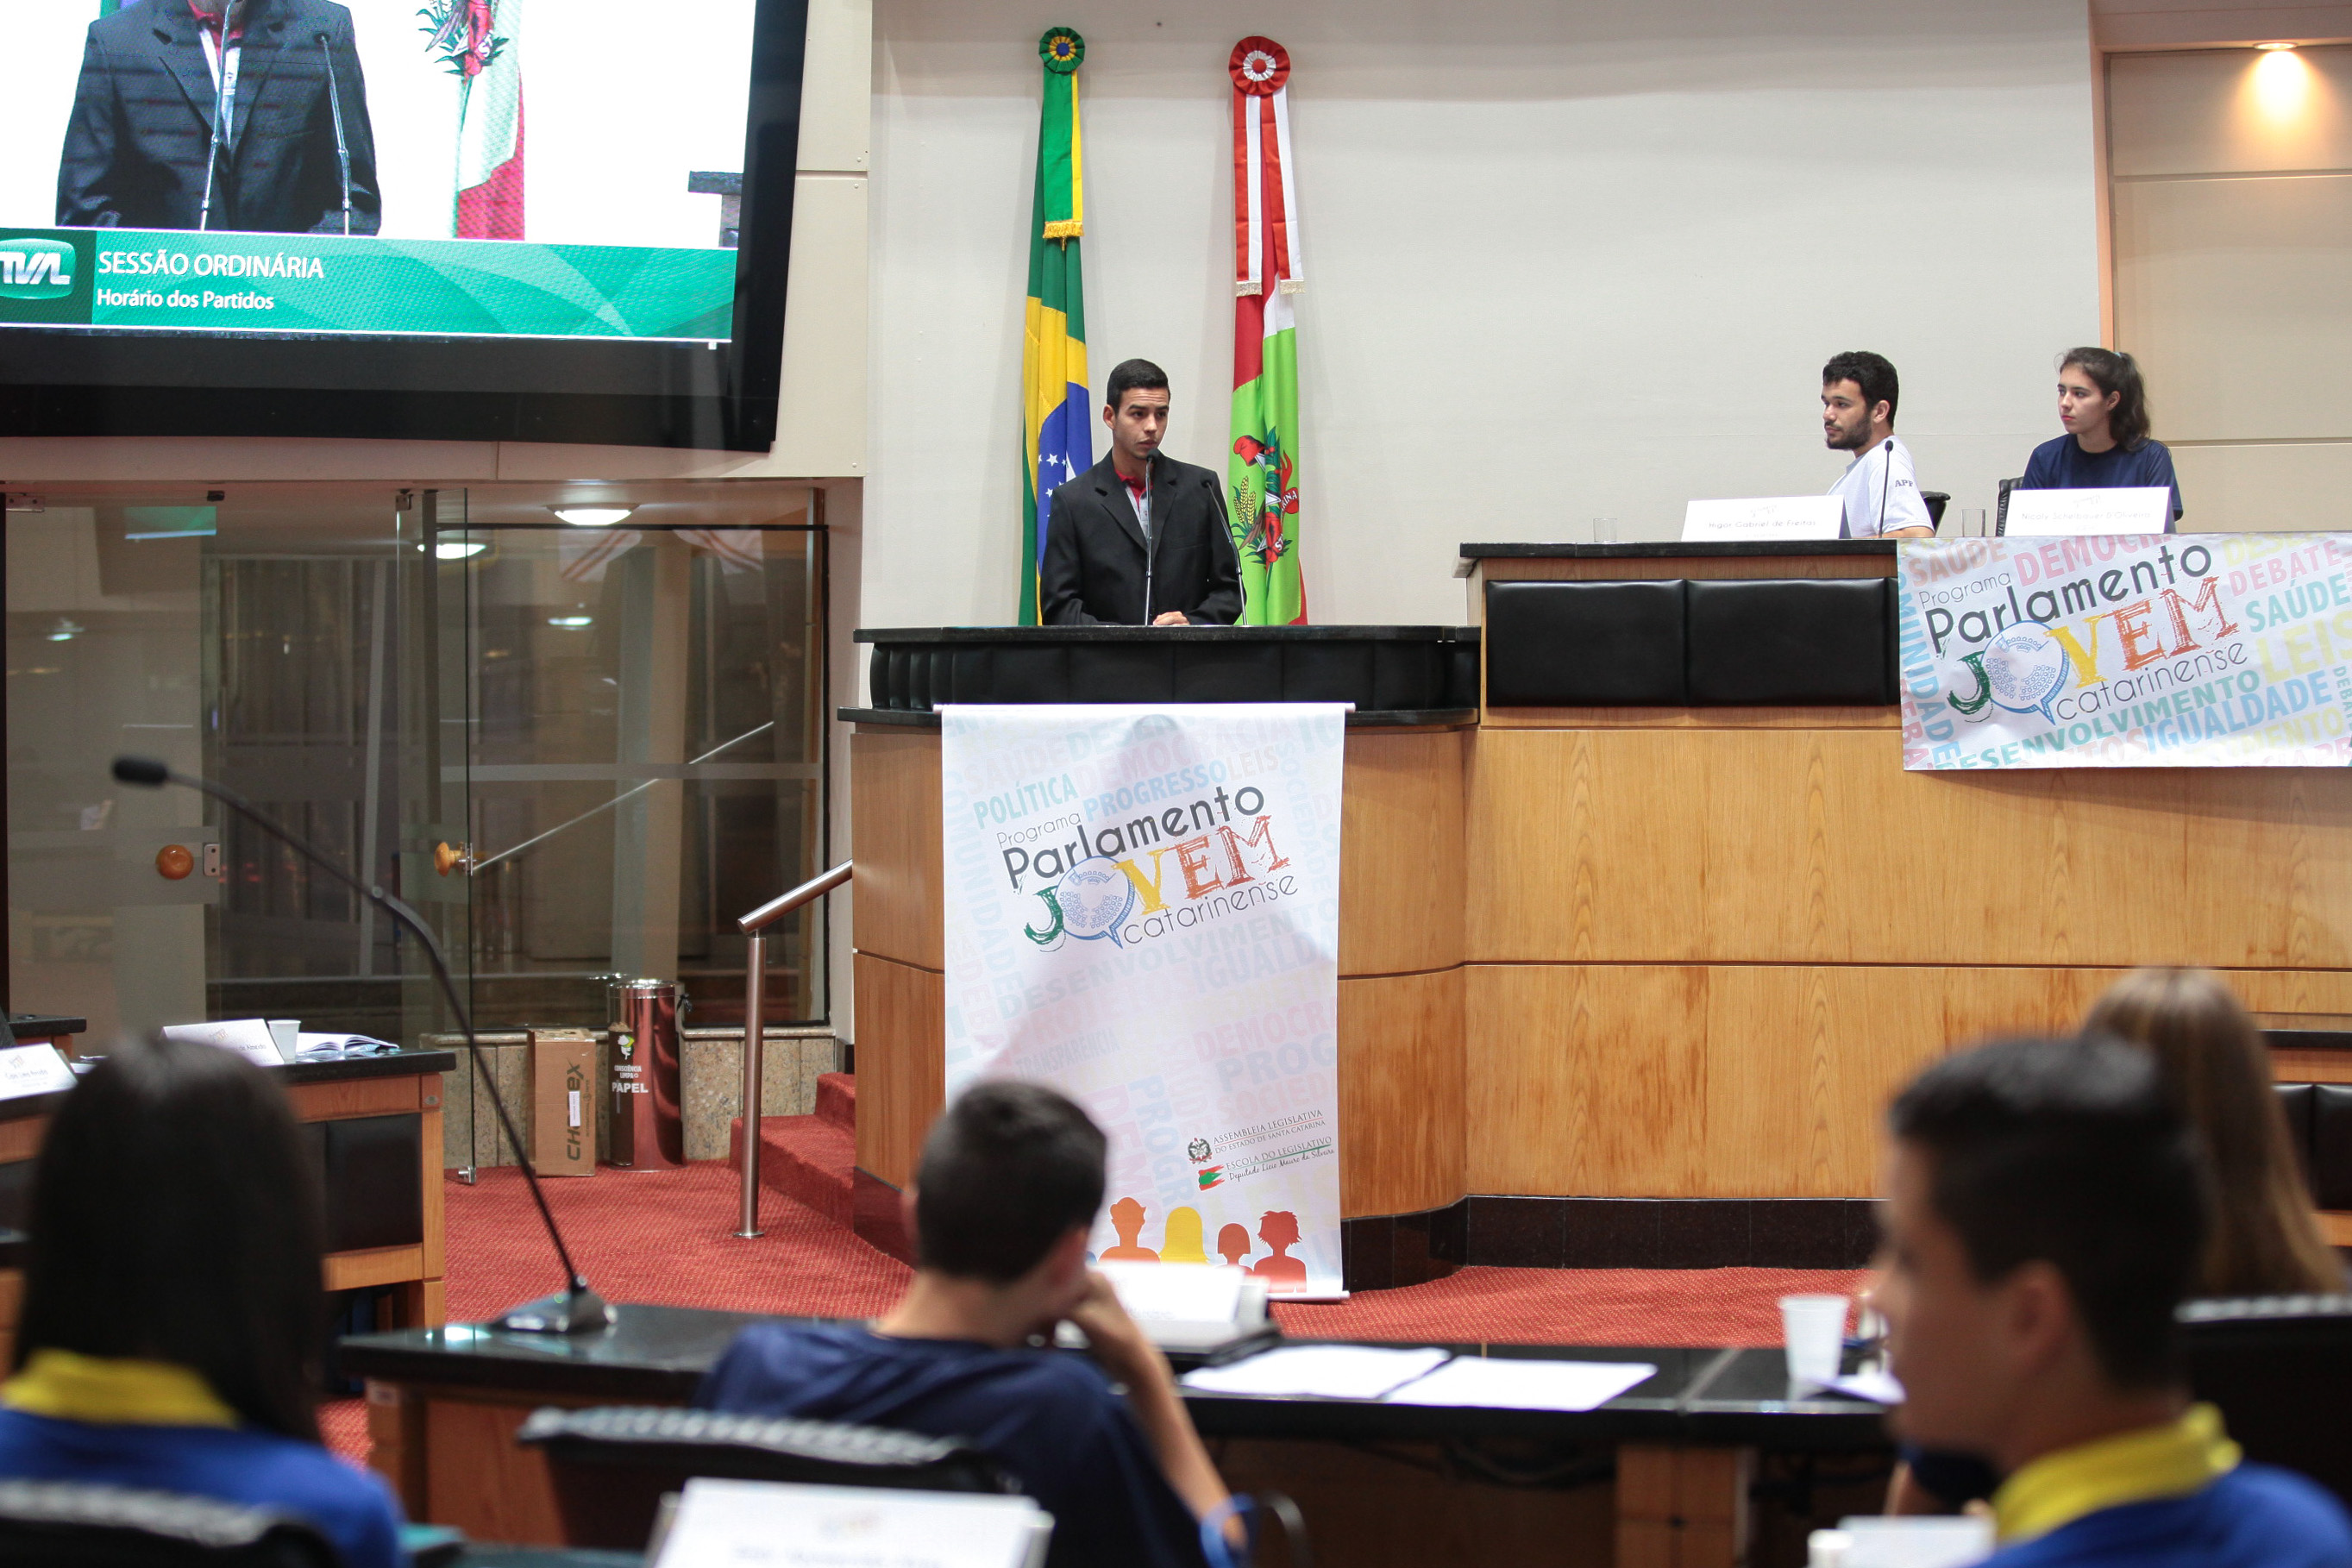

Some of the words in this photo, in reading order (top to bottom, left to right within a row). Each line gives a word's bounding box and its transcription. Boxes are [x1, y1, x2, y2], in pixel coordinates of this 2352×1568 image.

[97, 249, 188, 276] SESSÃO
[194, 252, 325, 279] ORDINÁRIA
[97, 288, 164, 307] Horário
[167, 292, 199, 309] dos
[203, 292, 275, 310] Partidos
[1919, 572, 2011, 608] Programa
[2228, 539, 2343, 597] DEBATE
[1925, 544, 2211, 655] Parlamento
[2245, 573, 2352, 633] SAÚDE
[2056, 640, 2249, 720] catarinense
[2142, 669, 2333, 755] IGUALDADE
[973, 773, 1079, 830] POLÍTICA
[1082, 759, 1227, 823] PROGRESSO
[995, 812, 1082, 850] Programa
[1001, 786, 1265, 890] Parlamento
[1123, 875, 1299, 944] catarinense
[612, 1082, 649, 1094] PAPEL
[1213, 1124, 1266, 1145] ASSEMBLEIA
[1268, 1109, 1324, 1132] LEGISLATIVA
[1214, 1145, 1227, 1155] DO
[1229, 1138, 1256, 1151] ESTADO
[1257, 1135, 1267, 1144] DE
[1267, 1129, 1290, 1141] SANTA
[1290, 1120, 1327, 1135] CATARINA
[1226, 1156, 1259, 1170] ESCOLA
[1261, 1151, 1276, 1162] DO
[1278, 1136, 1333, 1157] LEGISLATIVO
